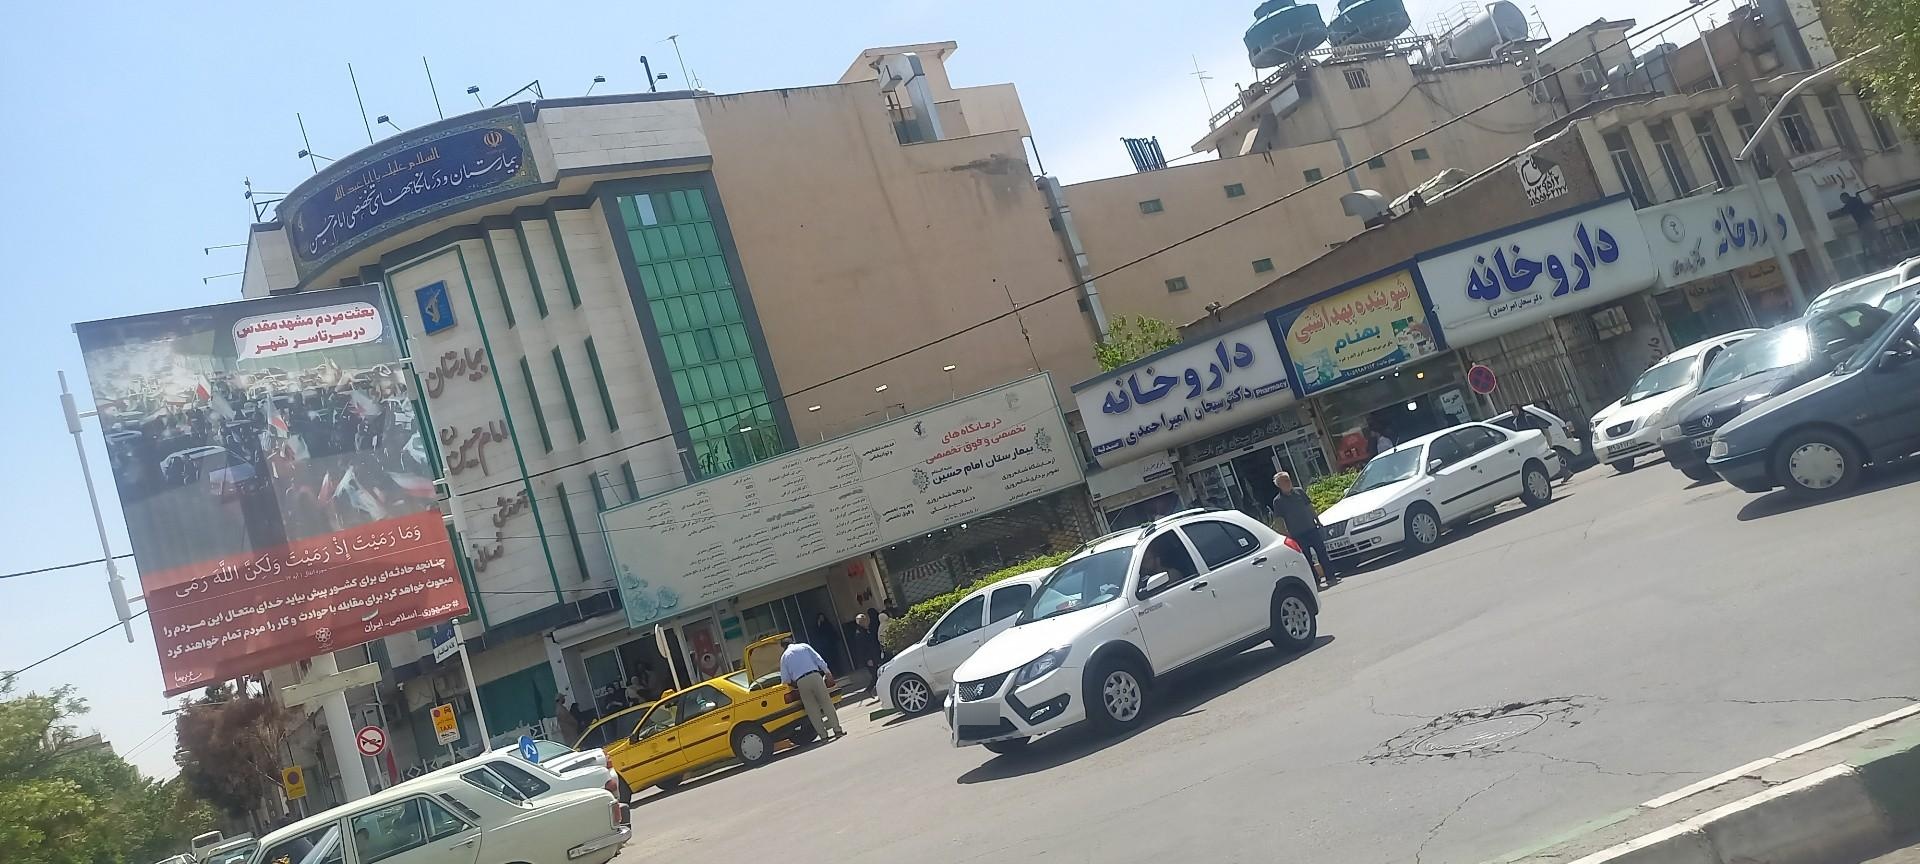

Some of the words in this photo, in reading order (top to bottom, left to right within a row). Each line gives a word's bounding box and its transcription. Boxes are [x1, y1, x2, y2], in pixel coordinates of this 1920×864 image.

[450, 153, 522, 188] بیمارستان
[443, 176, 448, 185] و
[348, 184, 376, 229] تخصصی
[333, 213, 346, 237] امام
[311, 215, 335, 254] حسین
[1467, 222, 1619, 298] داروخانه
[1533, 295, 1542, 304] دکتر
[346, 303, 374, 320] بعثت
[279, 314, 313, 330] مشهد
[315, 313, 344, 327] مردم
[1289, 303, 1355, 344] بهداشتی
[235, 319, 278, 338] مقدس
[353, 327, 365, 339] در
[255, 335, 288, 354] شهر
[293, 330, 353, 349] سرتاسر
[1334, 326, 1380, 354] بهنام
[425, 348, 489, 399] بیمارستان
[1101, 340, 1254, 415] داروخانه
[1254, 381, 1287, 396] Pharmacy
[1224, 386, 1253, 410] دکتر
[961, 418, 1002, 435] درمانگاه
[991, 424, 1026, 444] تخصصی
[942, 431, 960, 444] های
[984, 438, 989, 446] و
[962, 438, 982, 453] فوق
[925, 447, 961, 465] تخصصی
[985, 446, 1033, 468] بیمارستان
[964, 459, 984, 476] امام
[933, 468, 962, 485] حسین
[416, 559, 446, 572] چنانچه
[329, 578, 357, 596] کشور
[359, 575, 376, 587] برای
[399, 581, 424, 595] خواهد
[426, 577, 453, 589] مبعوث
[285, 593, 305, 605] بیاید
[307, 588, 327, 601] پیش
[365, 594, 383, 606] برای
[384, 588, 397, 600] کرد
[256, 600, 283, 614] خدای
[329, 604, 336, 613] با
[338, 598, 364, 610] مقابله
[207, 612, 223, 627] این
[225, 607, 255, 622] متعال
[291, 618, 297, 626] و
[299, 609, 328, 621] حوادث
[174, 620, 206, 637] مردم
[267, 621, 275, 631] را
[277, 616, 289, 629] کار
[163, 626, 172, 637] را
[222, 629, 242, 646] تمام
[243, 626, 265, 640] مردم
[186, 635, 219, 652] خواهند
[167, 645, 182, 658] کرد
